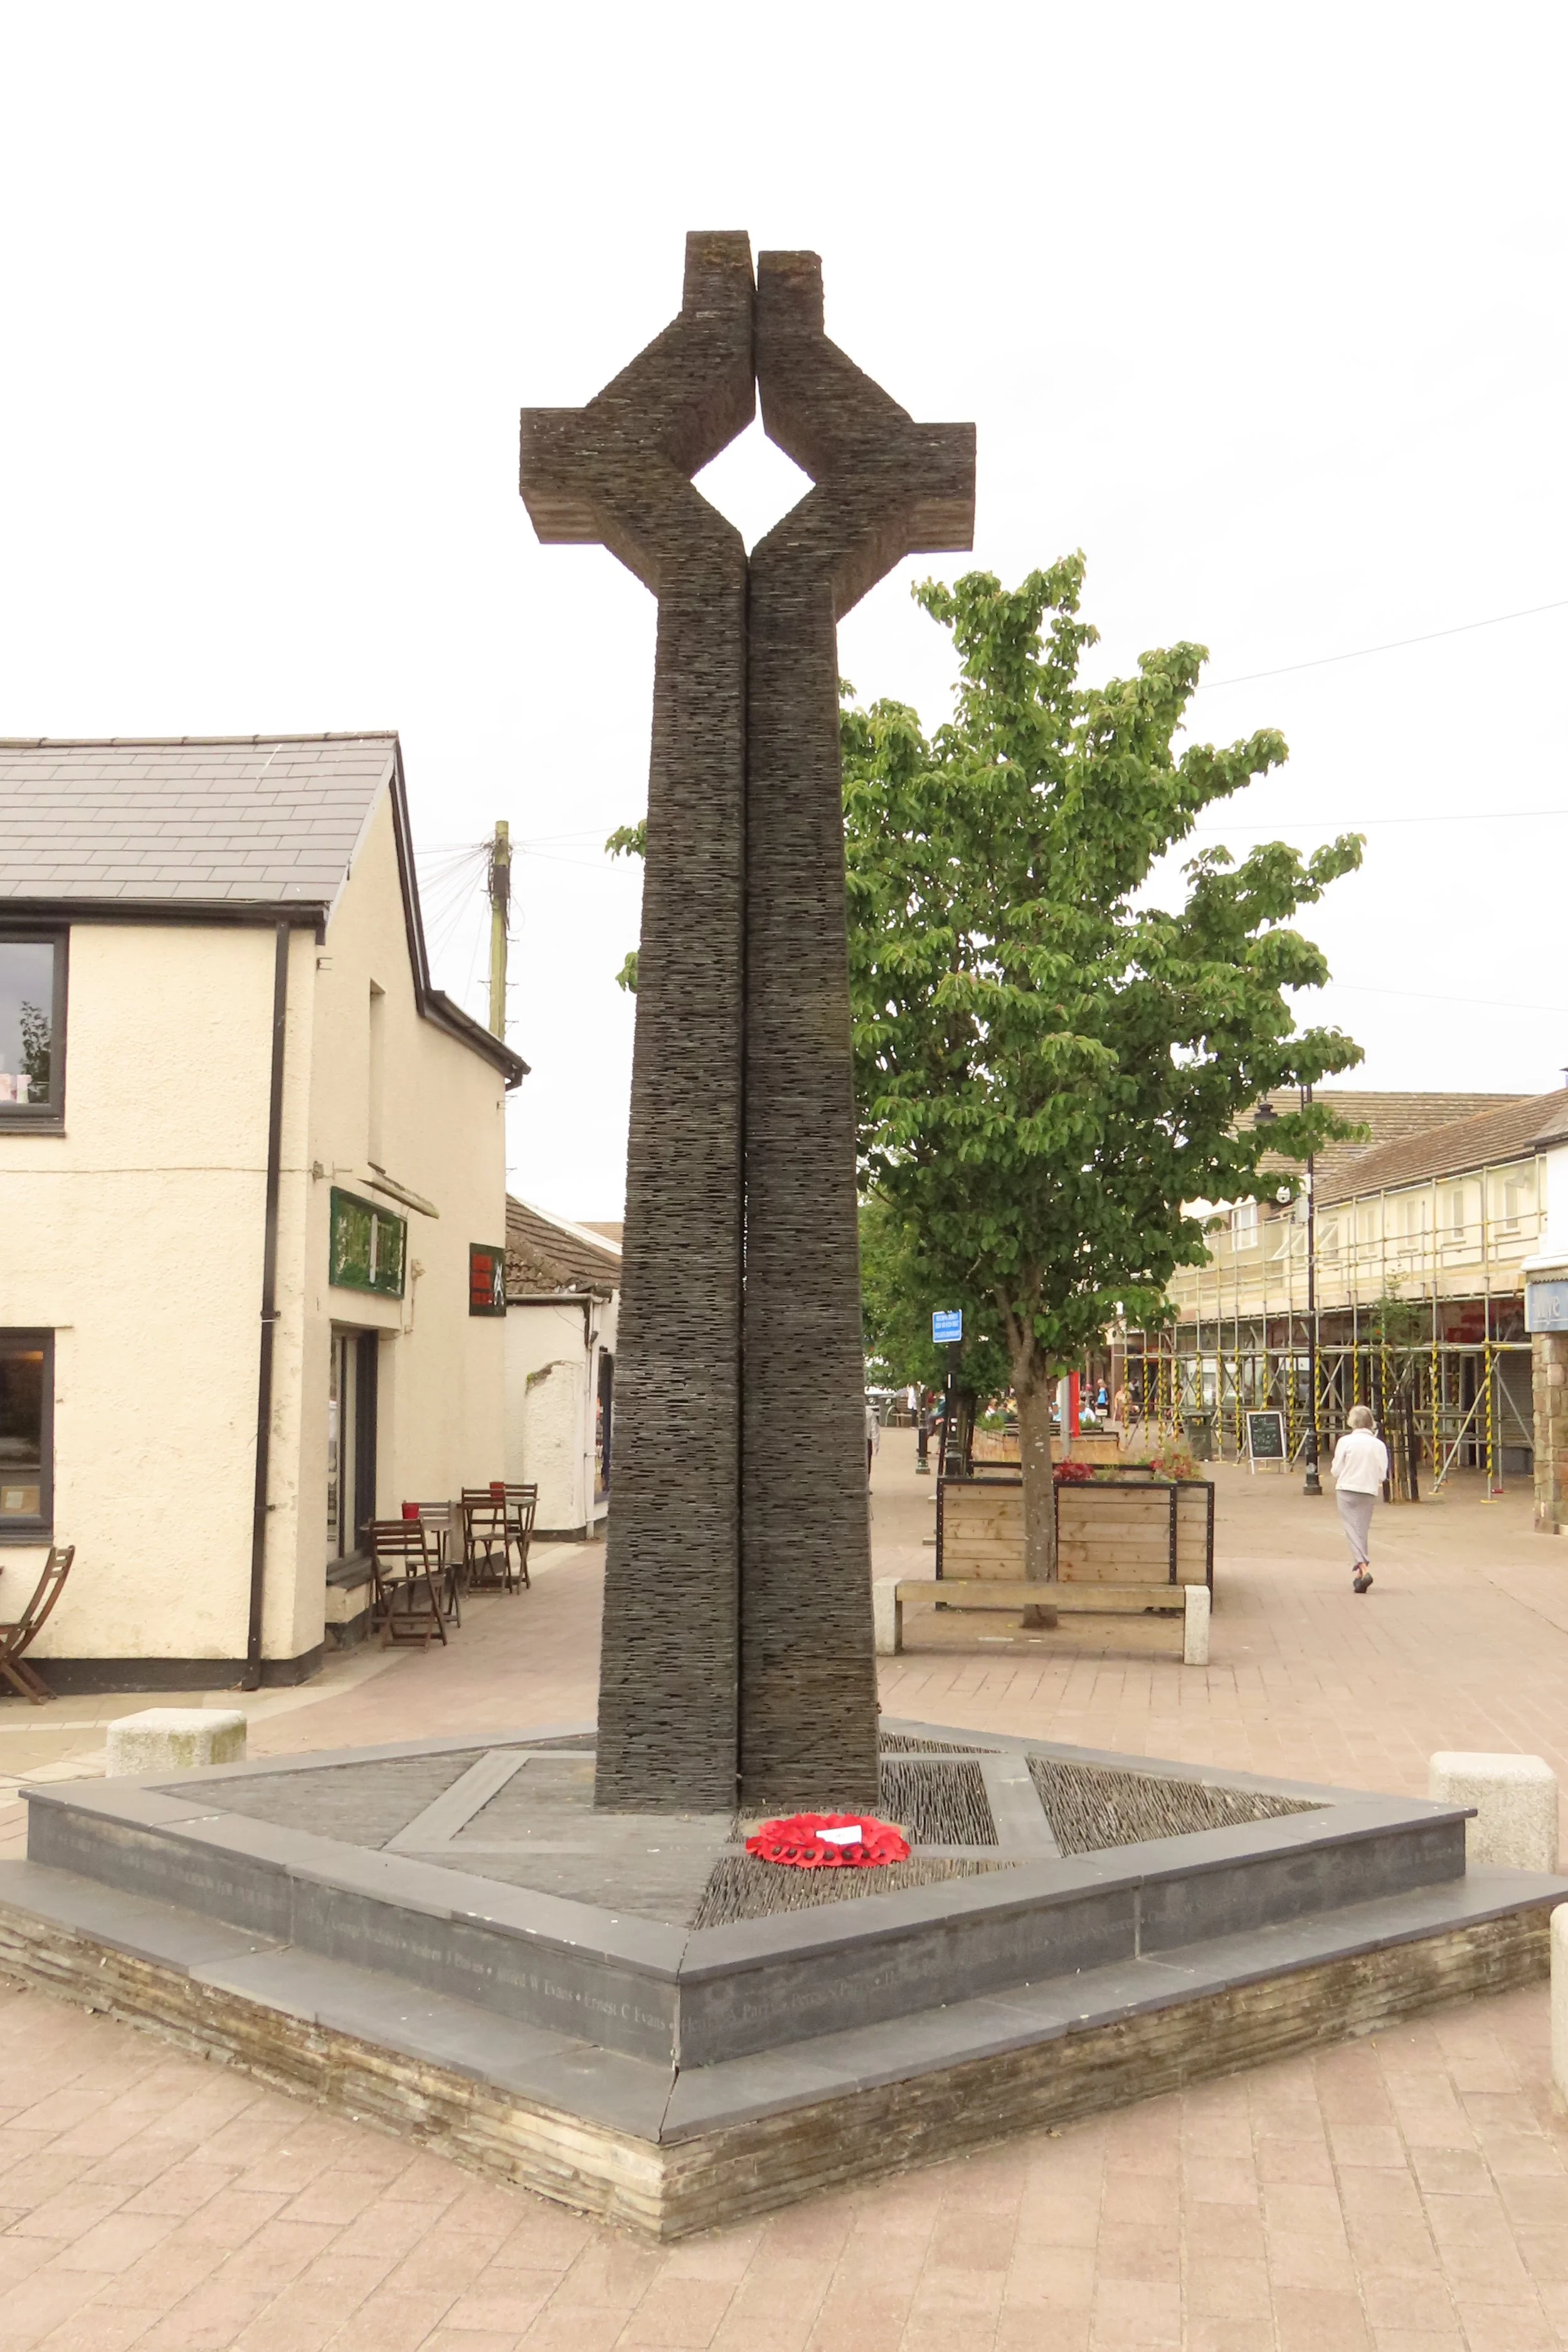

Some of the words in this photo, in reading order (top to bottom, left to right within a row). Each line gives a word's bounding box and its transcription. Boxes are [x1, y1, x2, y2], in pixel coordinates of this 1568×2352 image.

[544, 1979, 573, 2000] Evans
[585, 1993, 617, 2016] Ernest
[622, 2005, 630, 2019] C
[634, 2006, 665, 2030] Evans
